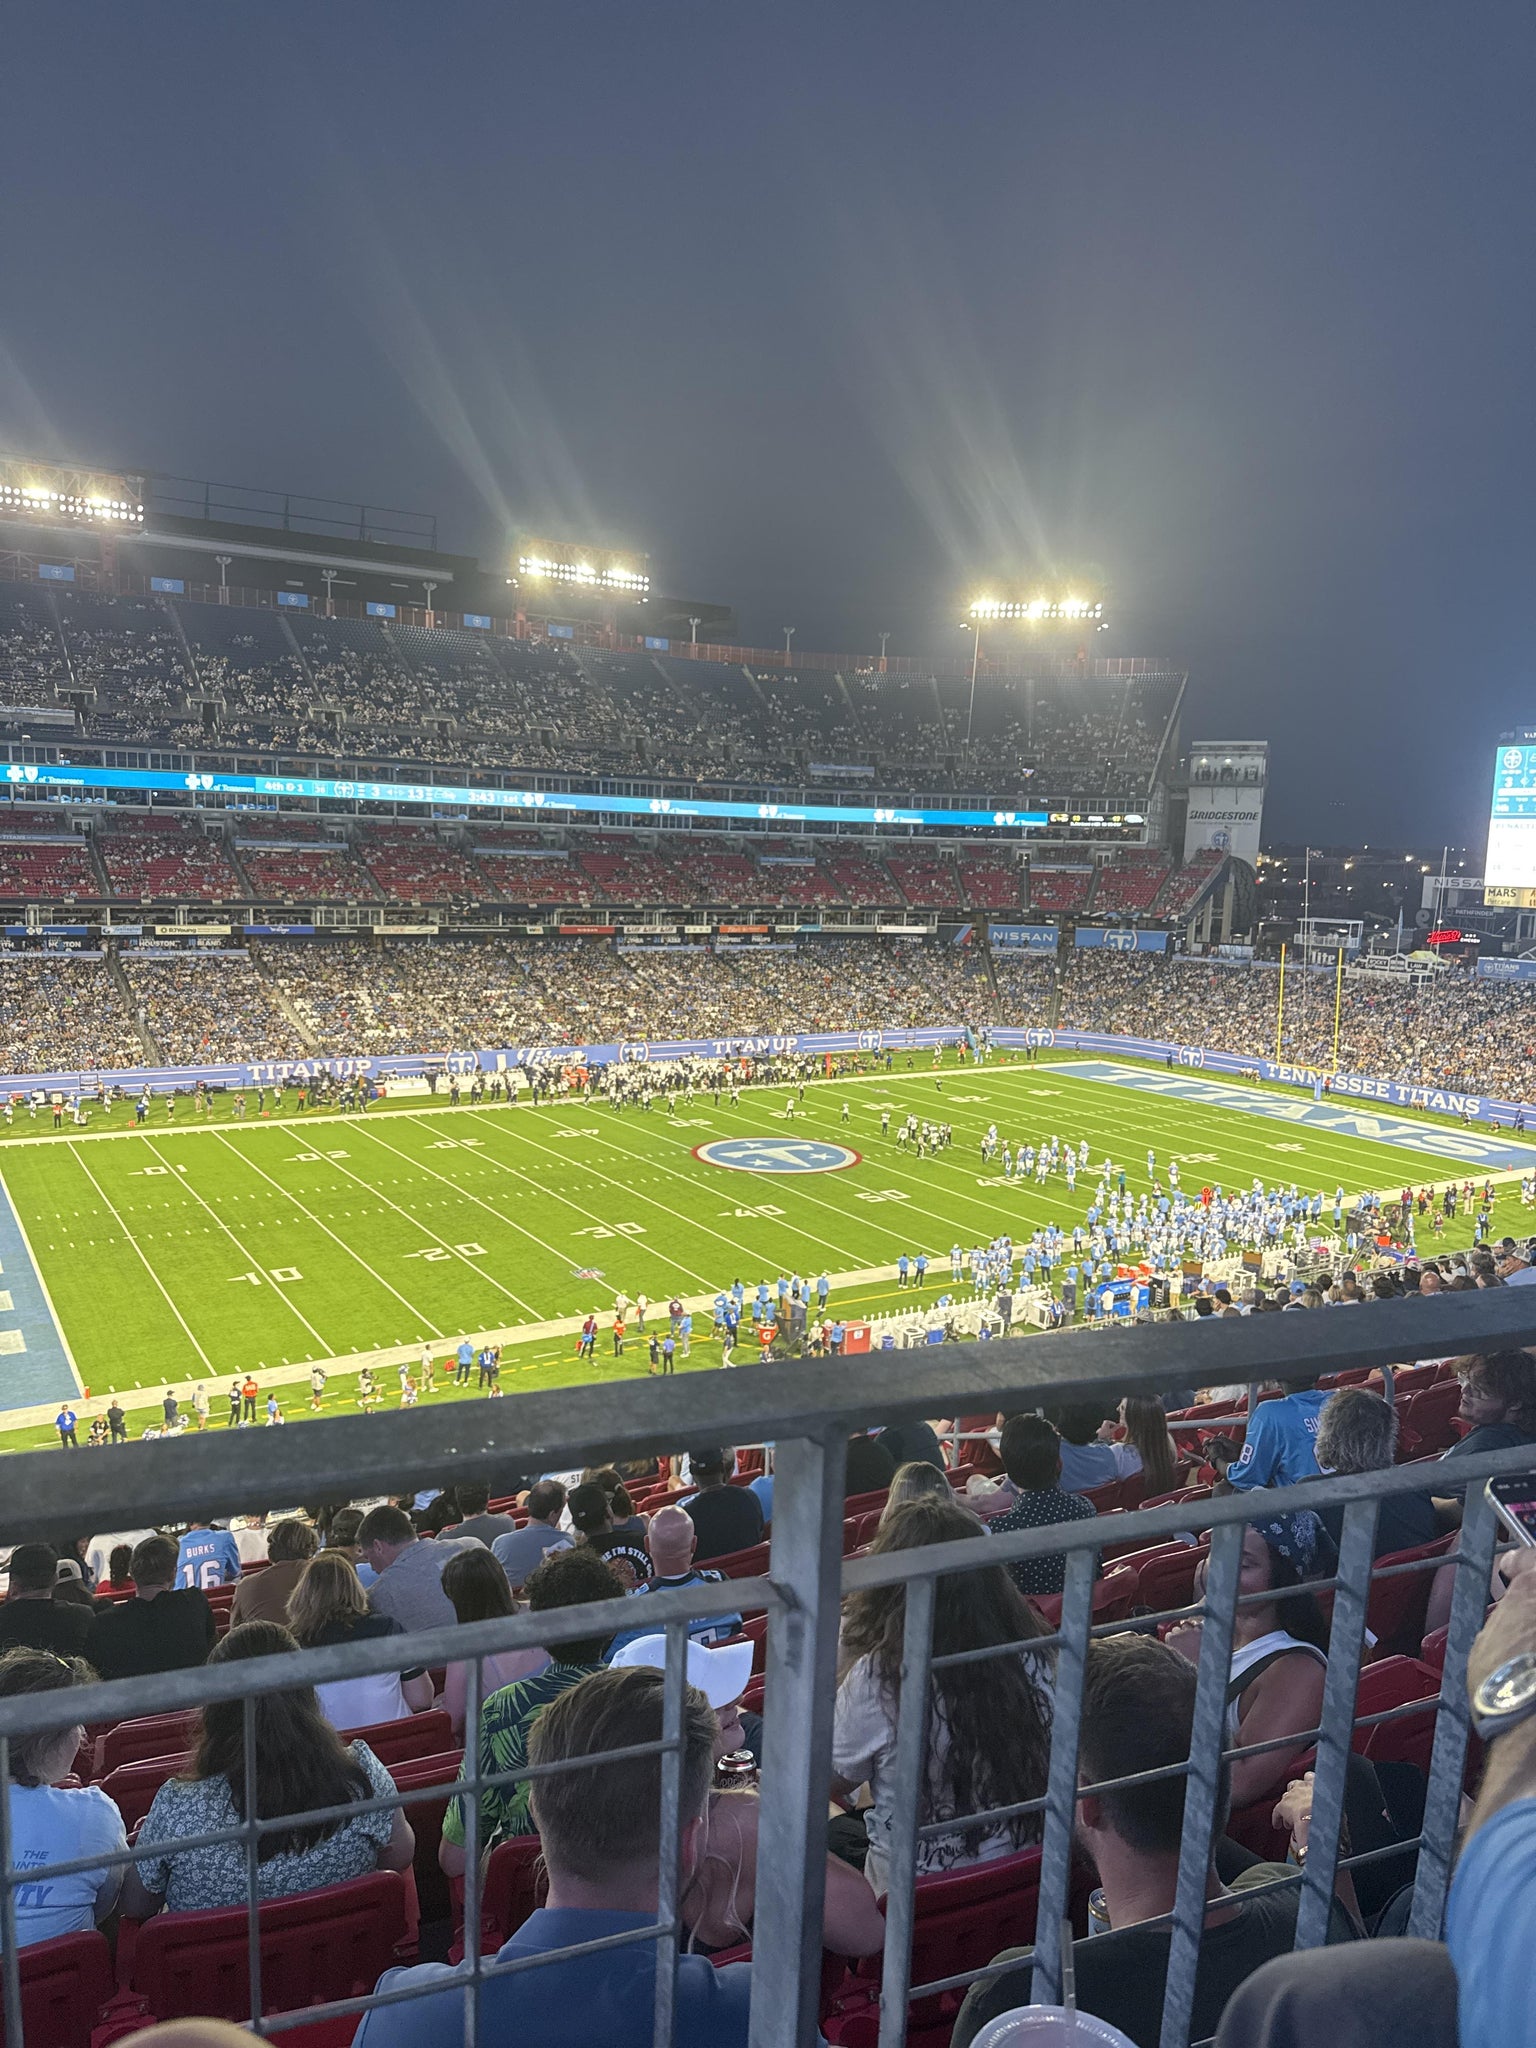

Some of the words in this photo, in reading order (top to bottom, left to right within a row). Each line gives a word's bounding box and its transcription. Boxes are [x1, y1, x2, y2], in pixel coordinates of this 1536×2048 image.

[264, 781, 284, 792] 4th
[468, 791, 495, 803] 3:43
[1189, 810, 1259, 820] BRIDGESTONE
[1488, 888, 1517, 898] MARS
[1455, 909, 1494, 917] PATHFINDER
[993, 931, 1053, 942] NISSAN
[712, 1039, 770, 1055] TITAN
[773, 1038, 798, 1051] UP
[247, 1061, 331, 1080] TITAN
[336, 1059, 372, 1077] UP
[1395, 1085, 1480, 1114] TITANS
[976, 1175, 1024, 1188] 40
[854, 1189, 912, 1203] 50
[734, 1204, 786, 1219] 40
[581, 1221, 648, 1239] 30
[417, 1242, 488, 1262] 20
[245, 1266, 304, 1286] 10
[762, 1331, 772, 1341] G
[186, 1543, 215, 1558] BURKS
[612, 1546, 627, 1557] I'M
[628, 1546, 649, 1566] STILL
[182, 1560, 221, 1590] 16
[23, 1849, 49, 1860] THE
